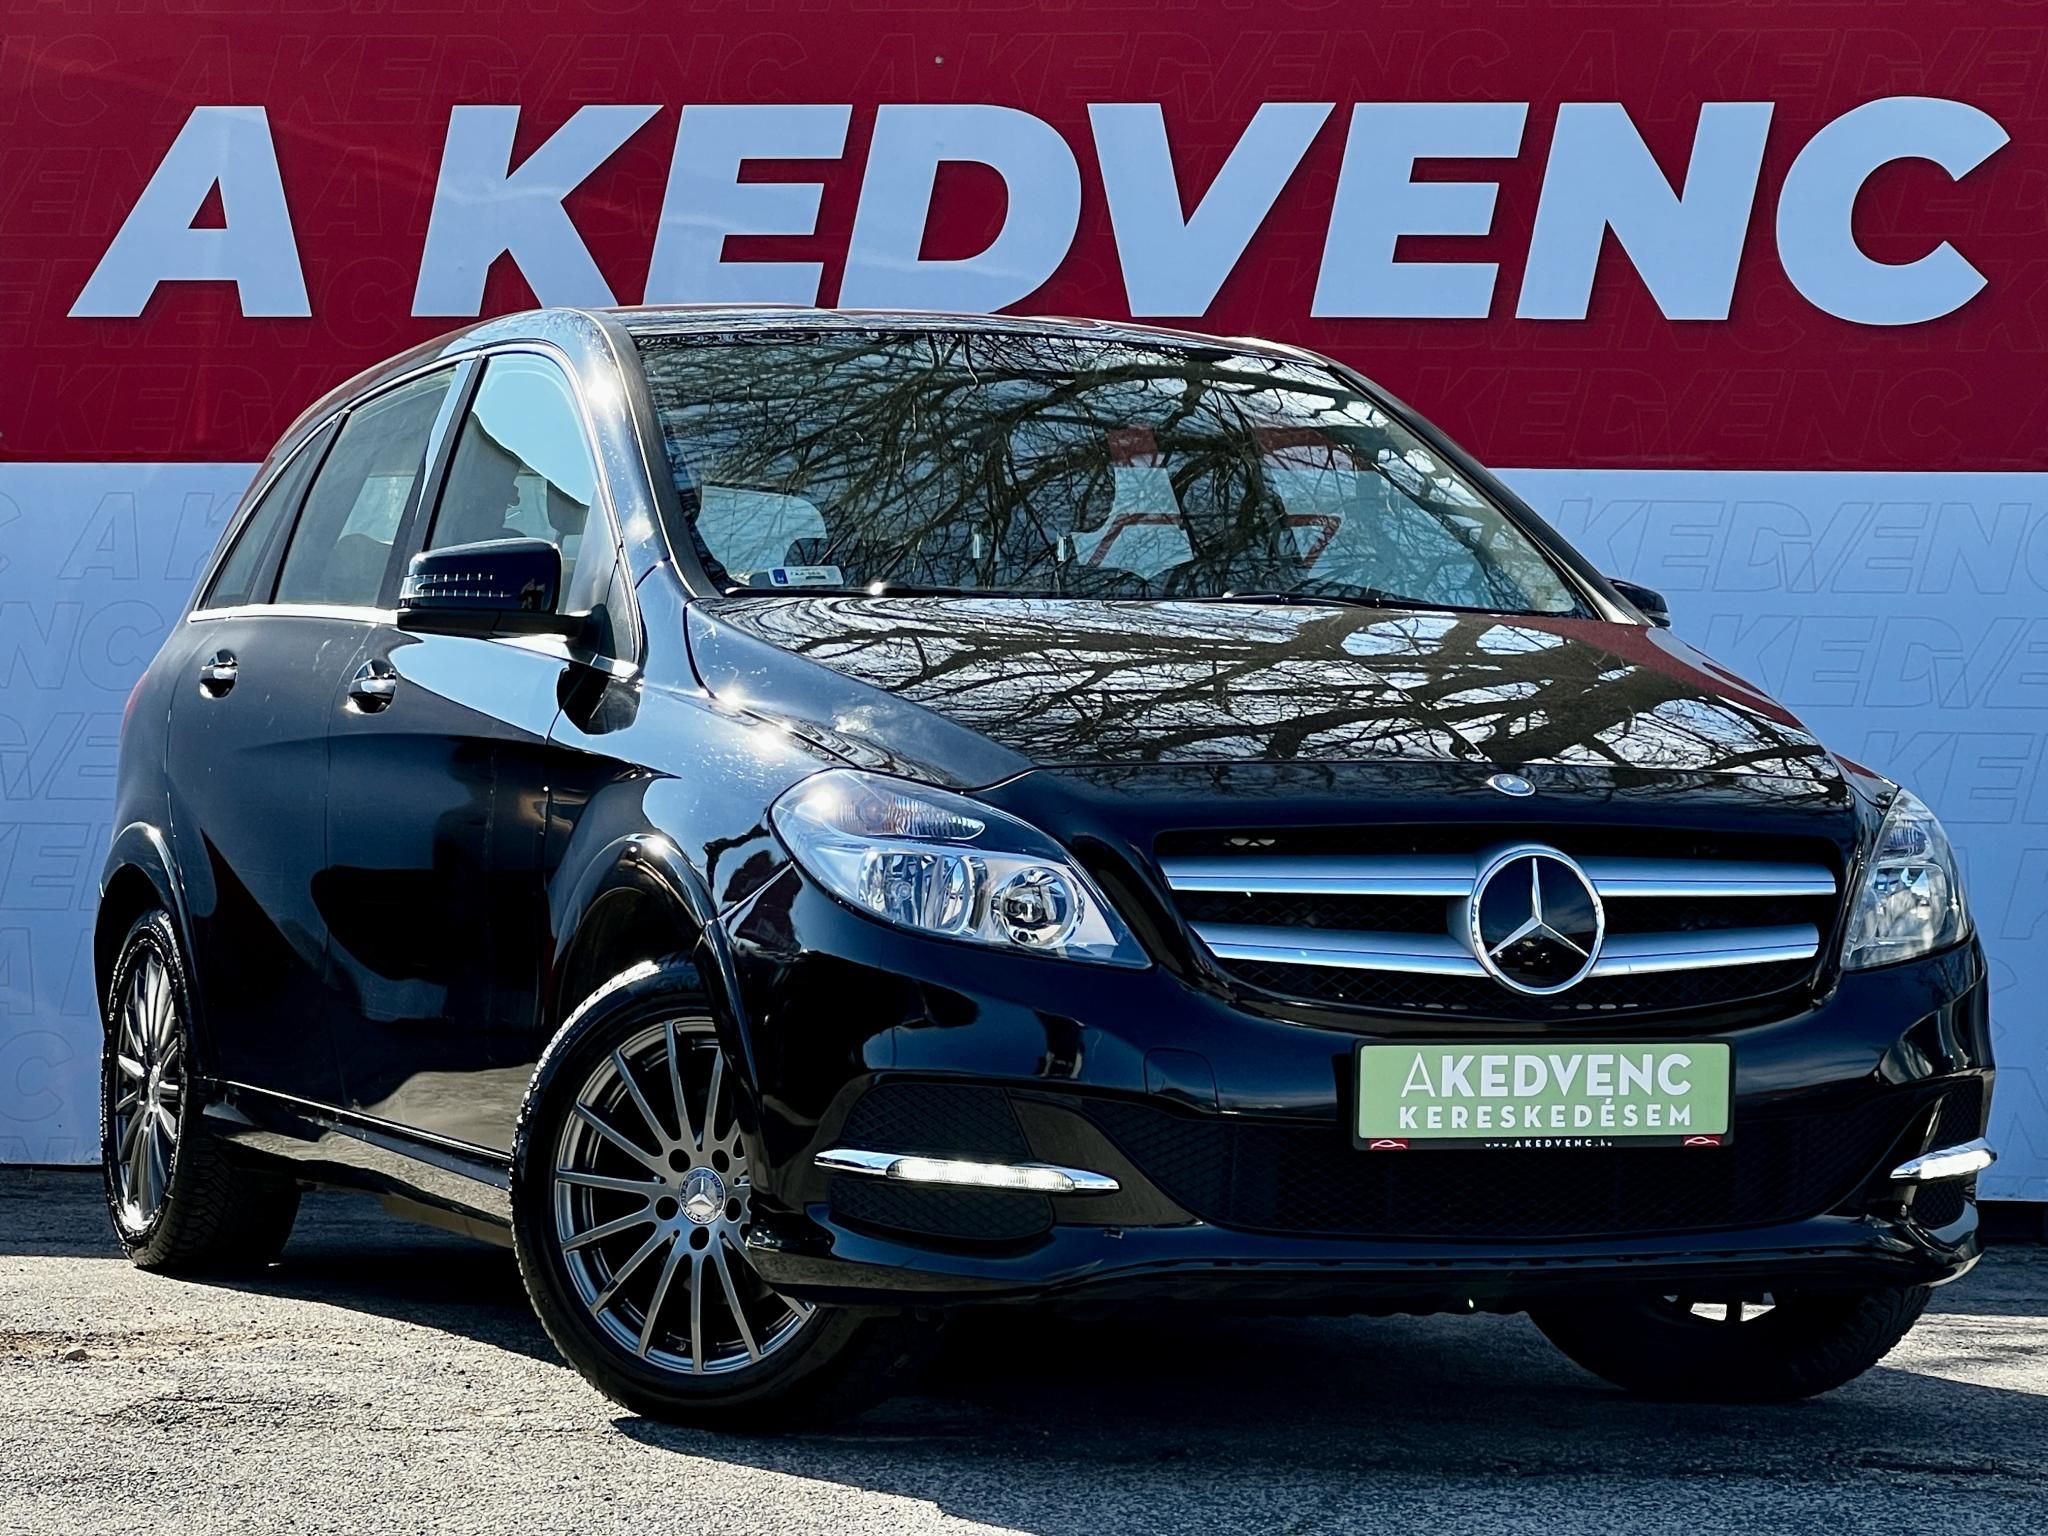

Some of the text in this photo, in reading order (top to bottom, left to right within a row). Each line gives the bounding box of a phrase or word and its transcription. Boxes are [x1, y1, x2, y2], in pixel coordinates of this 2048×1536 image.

[67, 105, 312, 318] A
[411, 96, 2011, 326] KEDVENC
[1400, 1099, 1692, 1129] KERESKEDÉSEM
